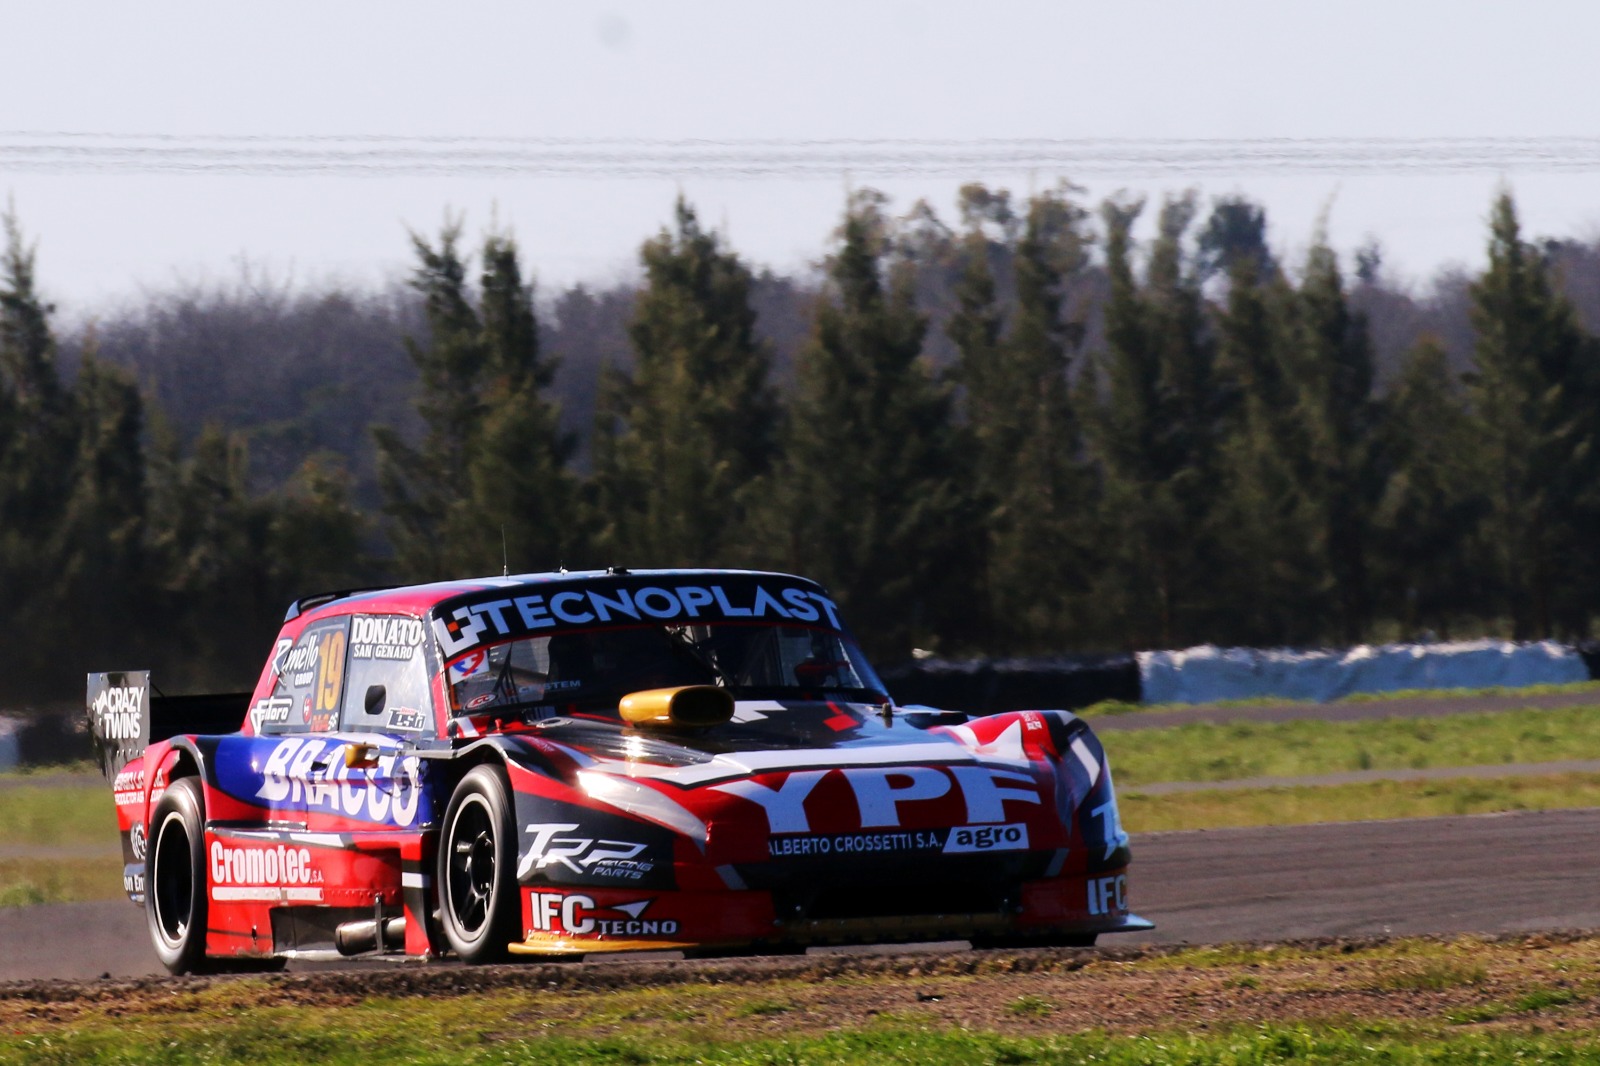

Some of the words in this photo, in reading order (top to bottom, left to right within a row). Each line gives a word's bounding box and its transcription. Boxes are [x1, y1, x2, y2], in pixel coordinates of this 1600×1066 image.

[471, 585, 842, 633] TECNOPLAST
[351, 618, 422, 646] DONATO
[354, 645, 372, 658] SAN
[375, 646, 413, 659] GENARO
[295, 672, 313, 686] GROUP
[316, 631, 344, 710] 19
[107, 686, 144, 713] CRAZY
[104, 712, 141, 739] TWINS
[255, 738, 420, 826] BRACCO
[705, 766, 1041, 833] YPF
[768, 837, 830, 856] ALBERTO
[834, 833, 912, 852] CROSSETTI
[916, 832, 943, 849] S.A.
[956, 825, 1021, 849] agro
[211, 841, 311, 884] Cromotec
[517, 824, 648, 879] TRP
[592, 868, 644, 879] PARTS
[1087, 874, 1129, 916] IFC
[531, 892, 595, 933] IFC
[598, 920, 677, 935] TECNO
